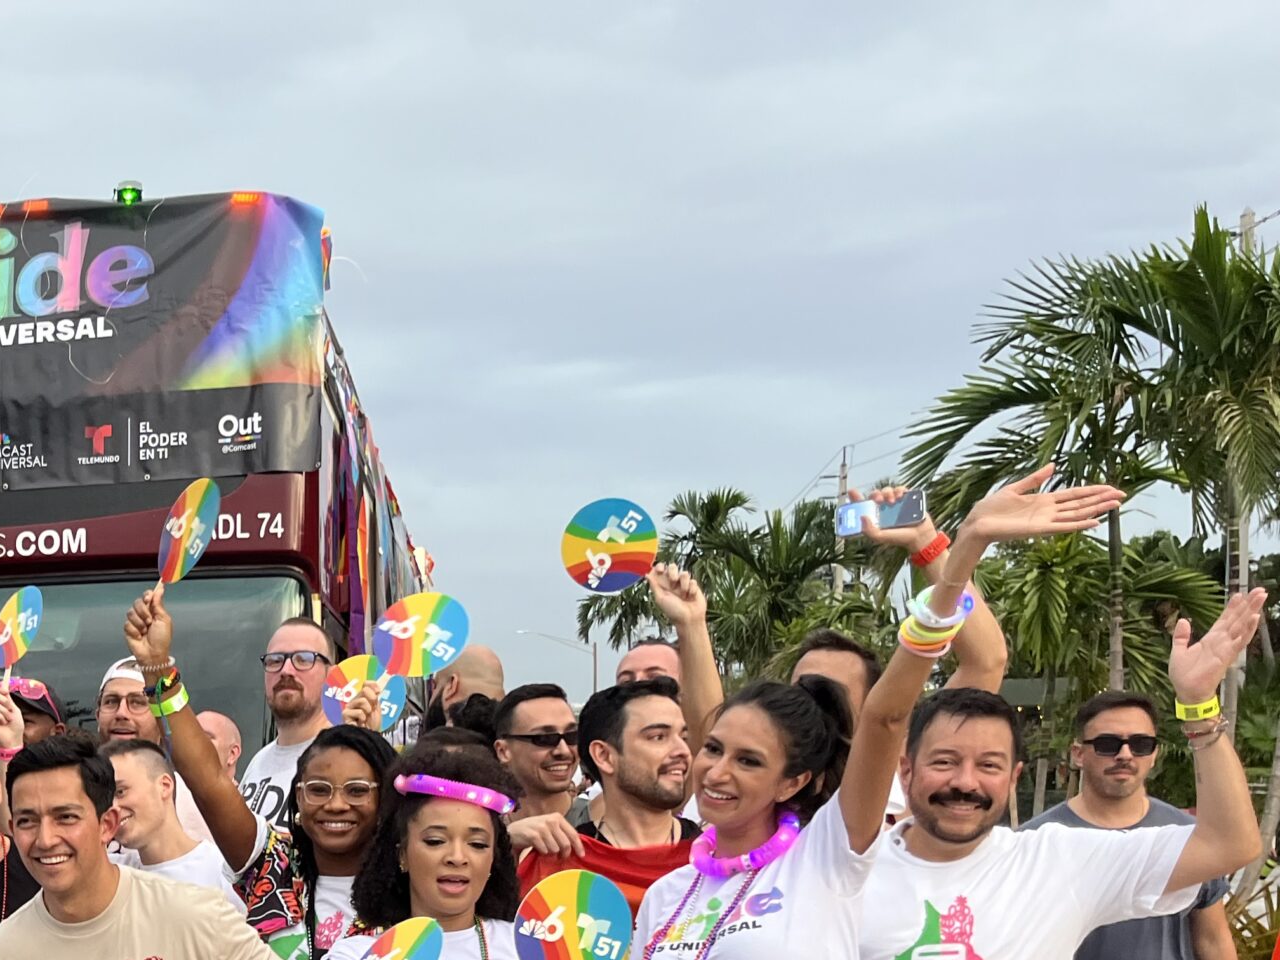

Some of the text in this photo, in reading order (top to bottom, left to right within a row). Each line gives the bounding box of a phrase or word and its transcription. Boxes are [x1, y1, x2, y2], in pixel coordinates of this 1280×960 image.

[139, 421, 154, 433] EL
[218, 411, 263, 437] Out
[139, 431, 188, 448] PODER
[139, 447, 169, 460] EN TI
[222, 442, 257, 454] @Comcast
[77, 455, 121, 465] TELEMUNDO
[257, 512, 284, 539] 74
